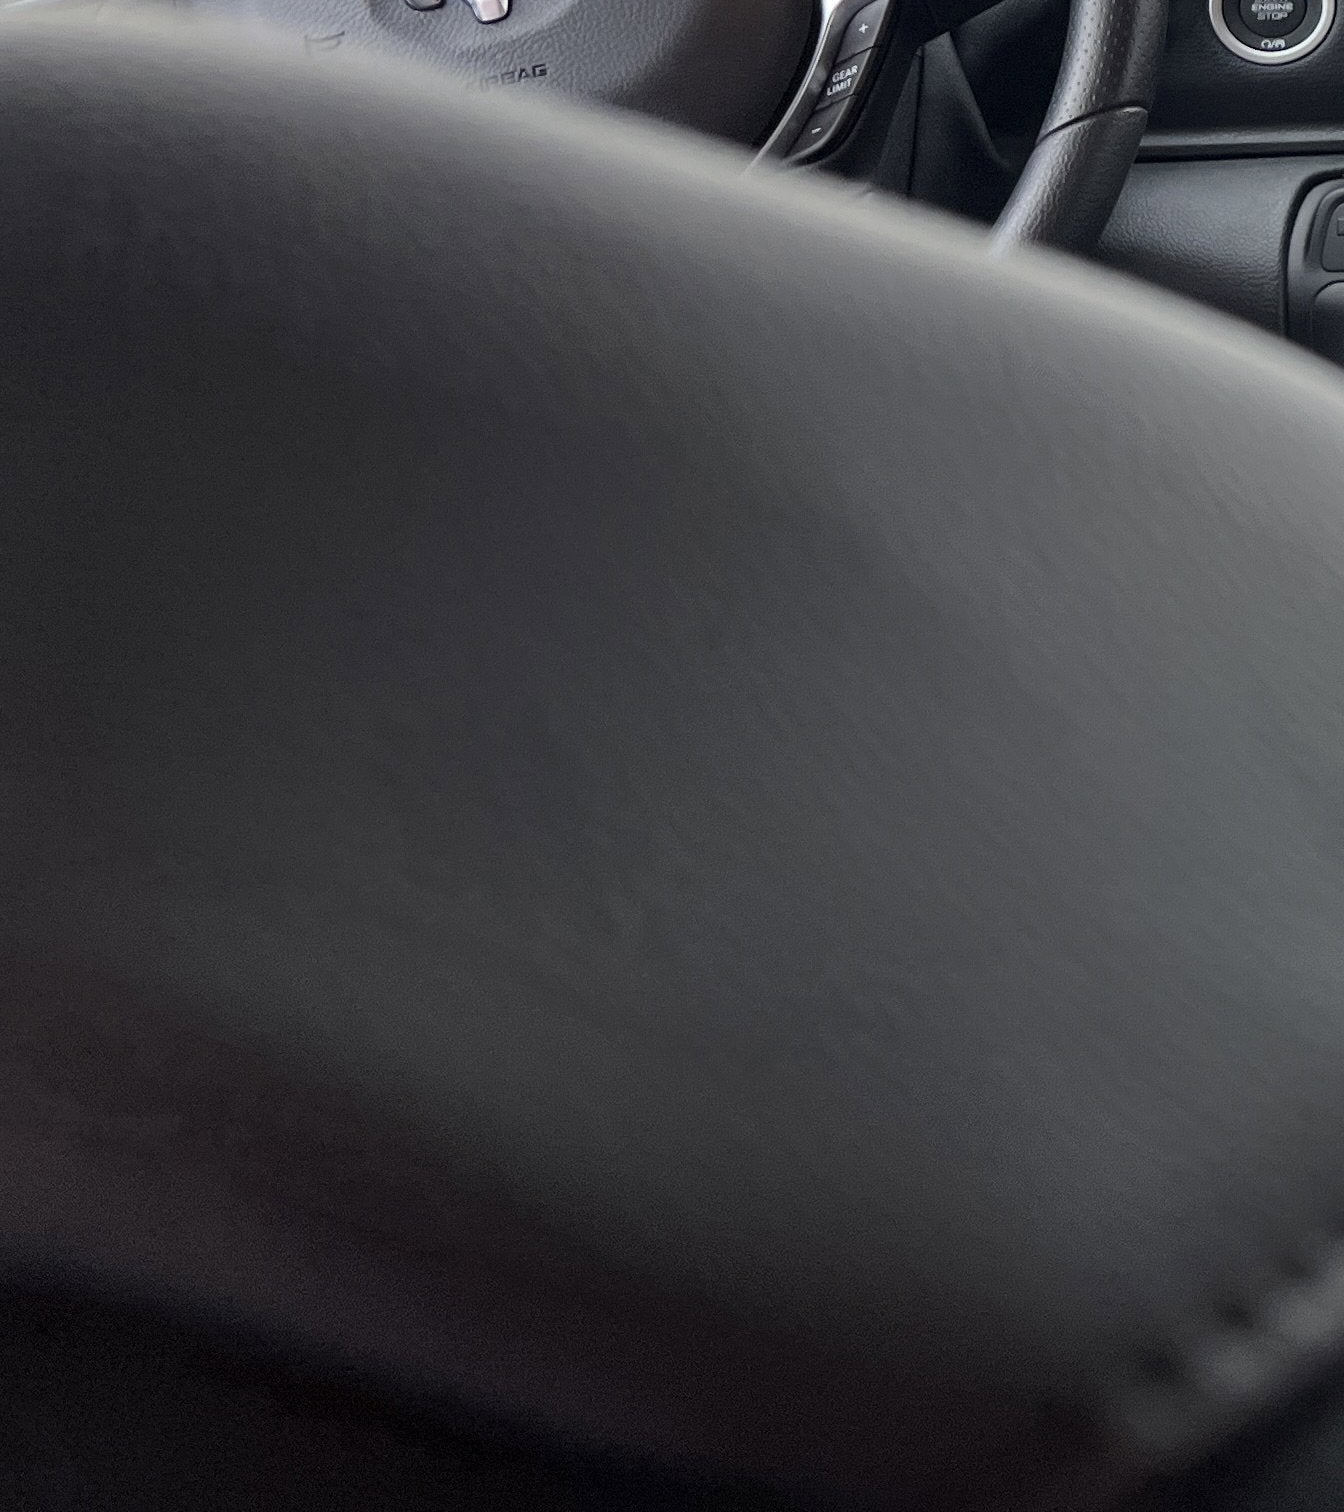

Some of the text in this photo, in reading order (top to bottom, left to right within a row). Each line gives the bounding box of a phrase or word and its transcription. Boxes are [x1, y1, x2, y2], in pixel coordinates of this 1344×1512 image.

[1251, 1, 1294, 12] ENGINE
[1257, 11, 1288, 21] STOP
[831, 64, 858, 83] GEAR
[826, 78, 853, 96] LIMIT
